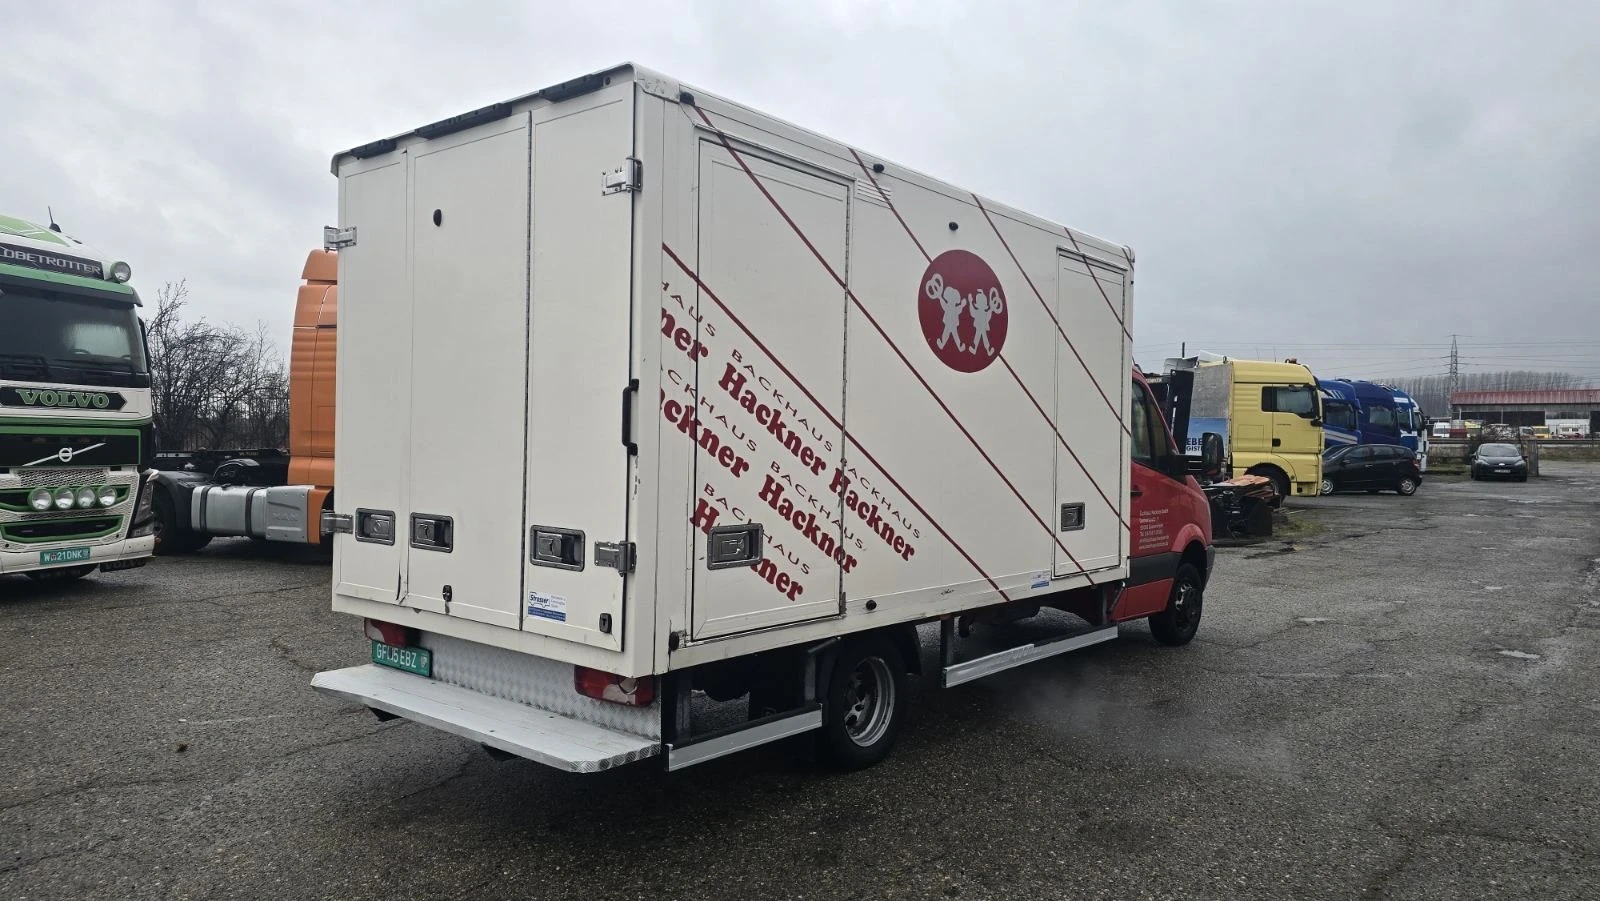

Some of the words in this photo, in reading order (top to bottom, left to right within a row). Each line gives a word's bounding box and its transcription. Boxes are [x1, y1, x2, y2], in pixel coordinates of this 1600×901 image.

[15, 388, 110, 408] VOLVO
[731, 349, 833, 452] BACKHAUS
[718, 362, 827, 476] Hackner
[829, 467, 915, 561] Hackner
[770, 460, 864, 549] BACKHAUS
[690, 498, 803, 601] Hner
[704, 483, 810, 574] BACHAUS
[758, 474, 857, 573] Hackner
